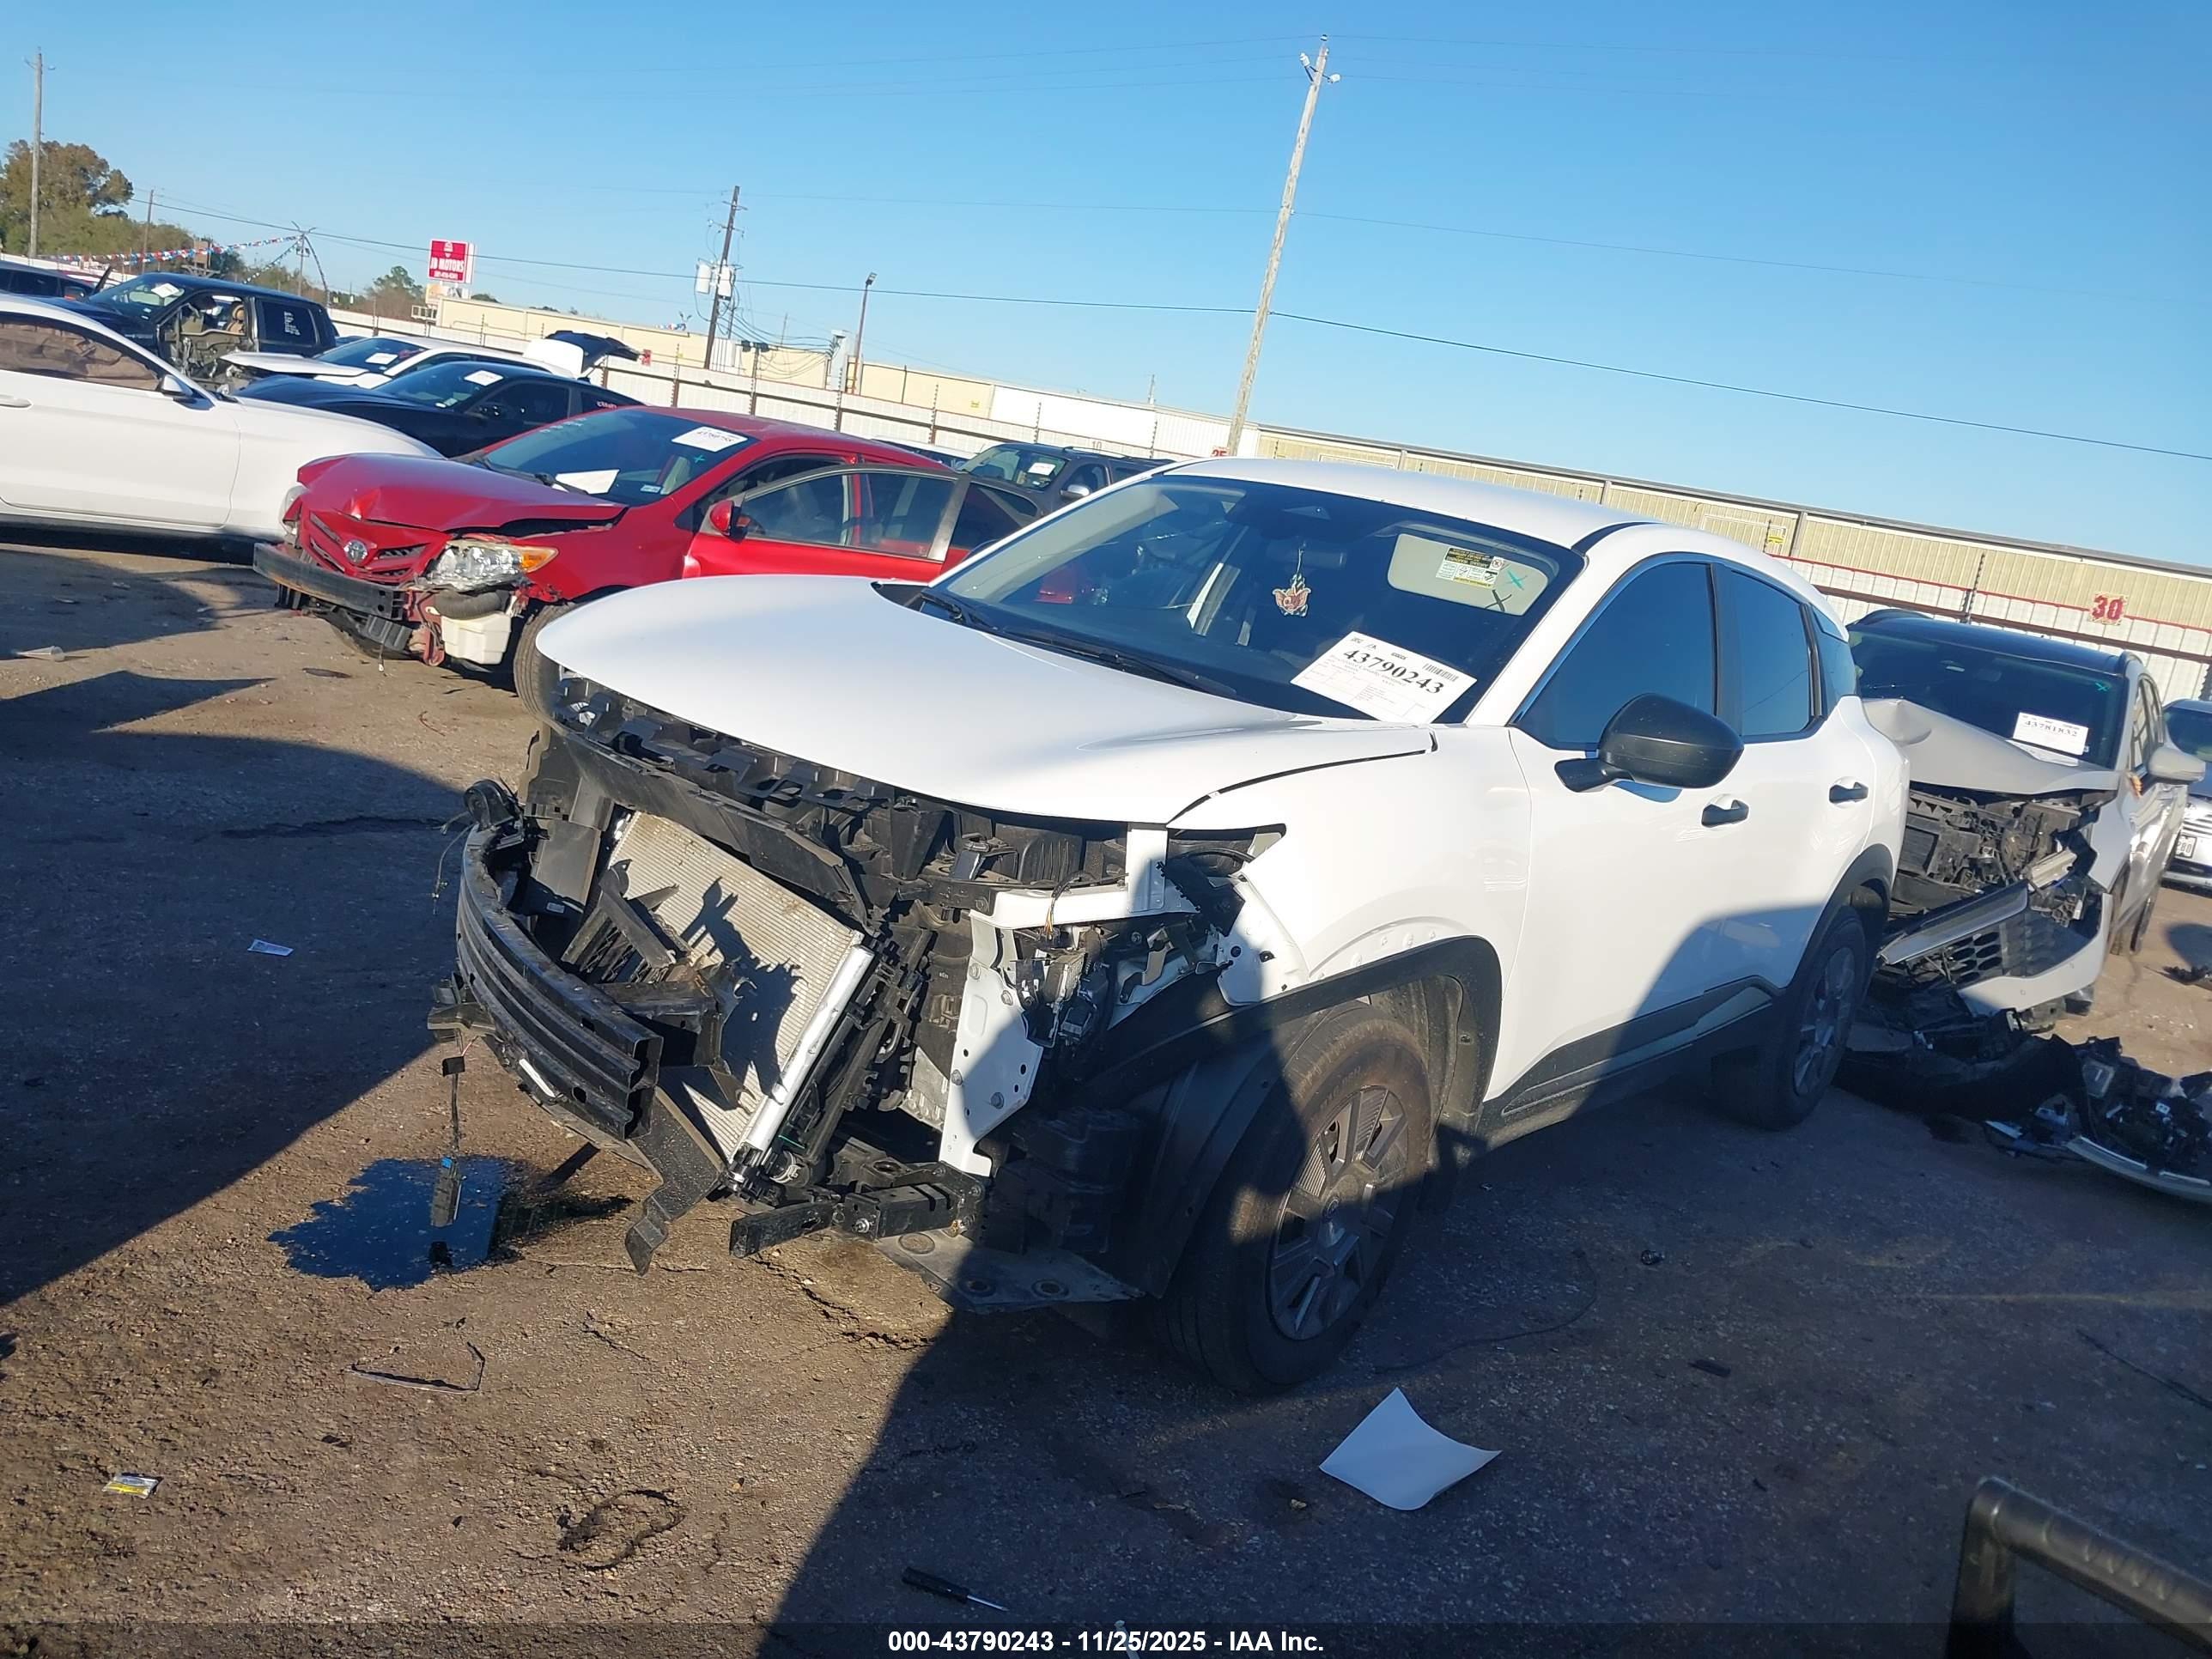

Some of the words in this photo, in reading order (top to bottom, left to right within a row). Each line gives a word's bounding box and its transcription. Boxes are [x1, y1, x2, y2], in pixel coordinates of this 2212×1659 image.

[438, 258, 465, 273] MOTORS
[2092, 595, 2123, 621] 30
[1343, 650, 1444, 694] 43790243
